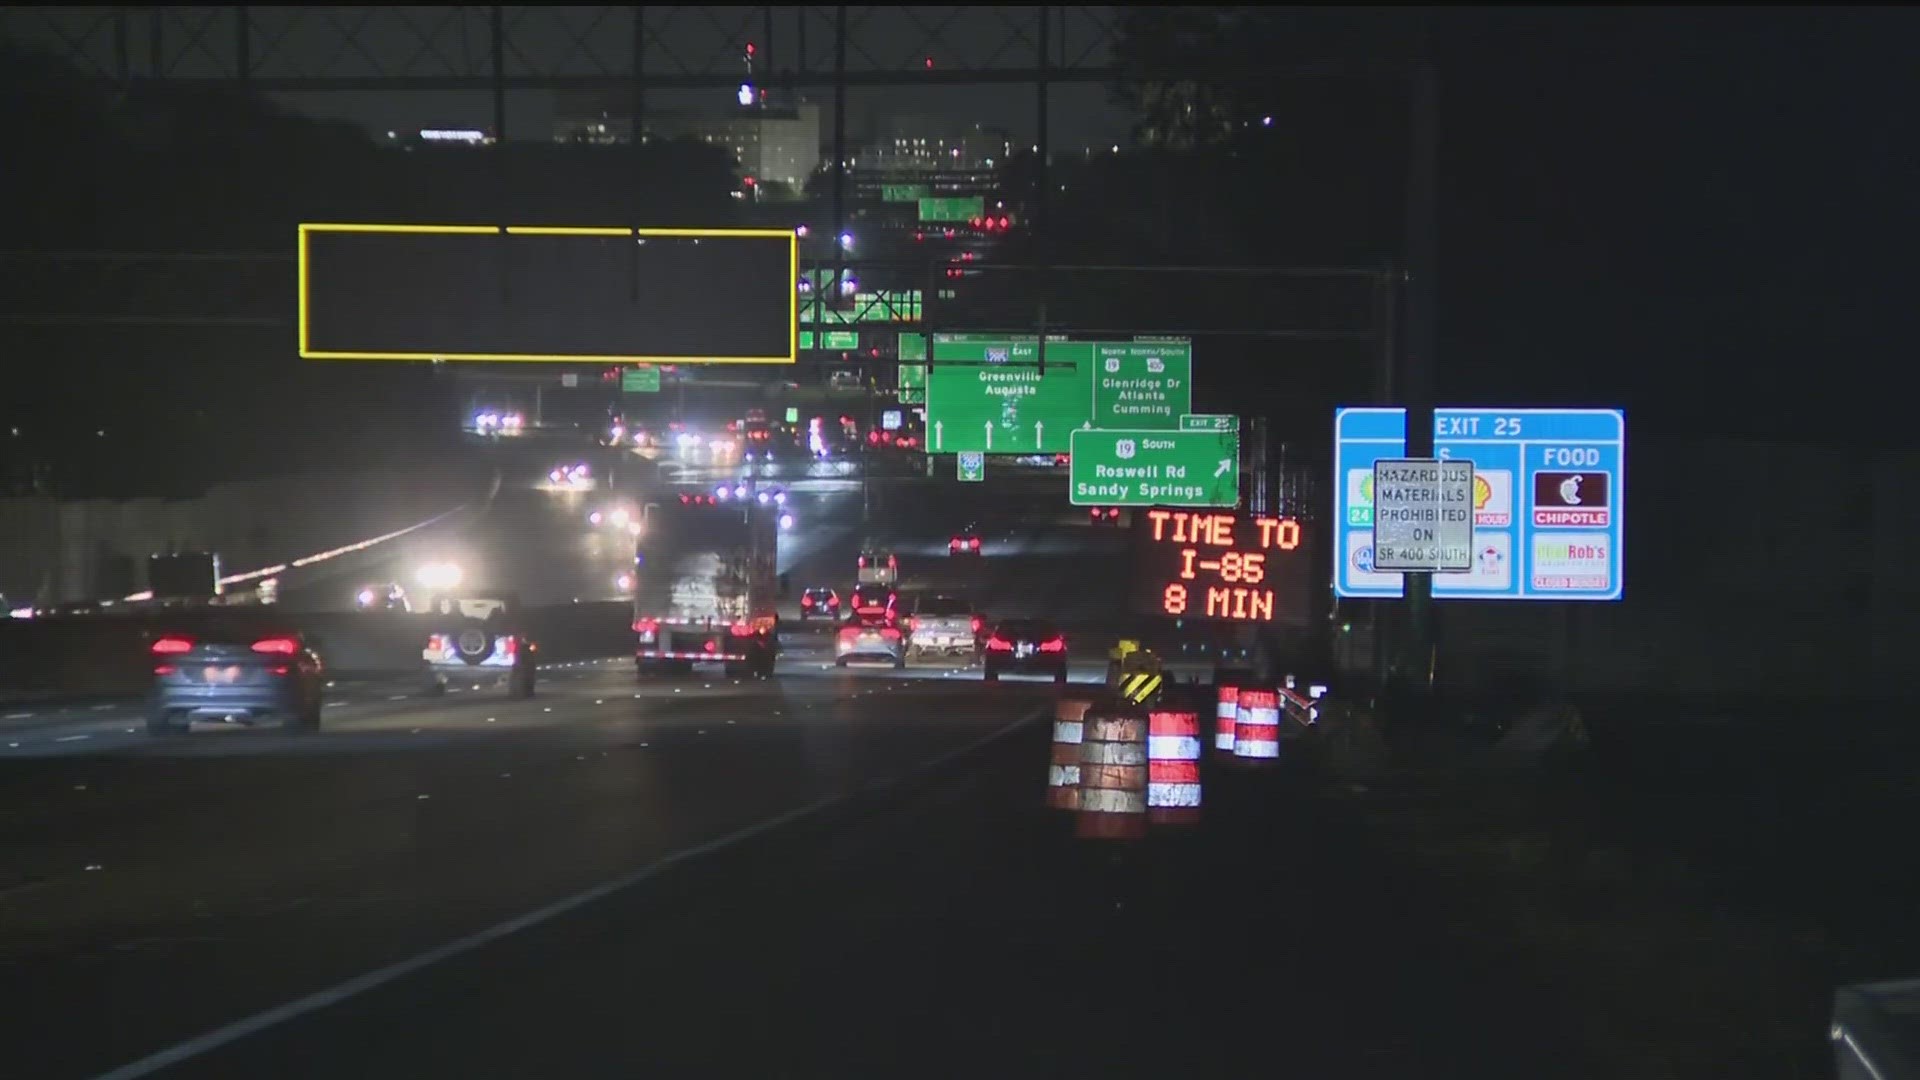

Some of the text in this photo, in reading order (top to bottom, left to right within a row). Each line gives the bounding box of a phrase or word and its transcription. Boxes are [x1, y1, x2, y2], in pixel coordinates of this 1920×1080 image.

[979, 371, 1042, 381] Greenville
[1102, 378, 1180, 390] Glenridge Dr
[985, 385, 1036, 397] Augusta
[1119, 391, 1165, 401] Atlanta
[1113, 404, 1171, 416] Cumming
[1436, 417, 1521, 436] EXIT 25
[1120, 443, 1132, 454] 19
[1543, 448, 1600, 466] FOOD
[1096, 464, 1186, 478] Roswell Rd
[1379, 469, 1468, 482] HAZARDOUS
[1077, 482, 1204, 500] Sandy Springs
[1382, 489, 1465, 501] MATERIALS
[1351, 509, 1369, 522] 24
[1381, 509, 1466, 521] PROHIBITED
[1535, 512, 1607, 524] CHIPOTLE
[1148, 511, 1300, 550] TIME TO
[1413, 528, 1434, 541] ON
[1379, 548, 1394, 560] SR
[1400, 548, 1424, 560] 400
[1429, 548, 1467, 560] SOUTH
[1180, 548, 1266, 584] I-85
[1164, 583, 1274, 620] 8 MIN
